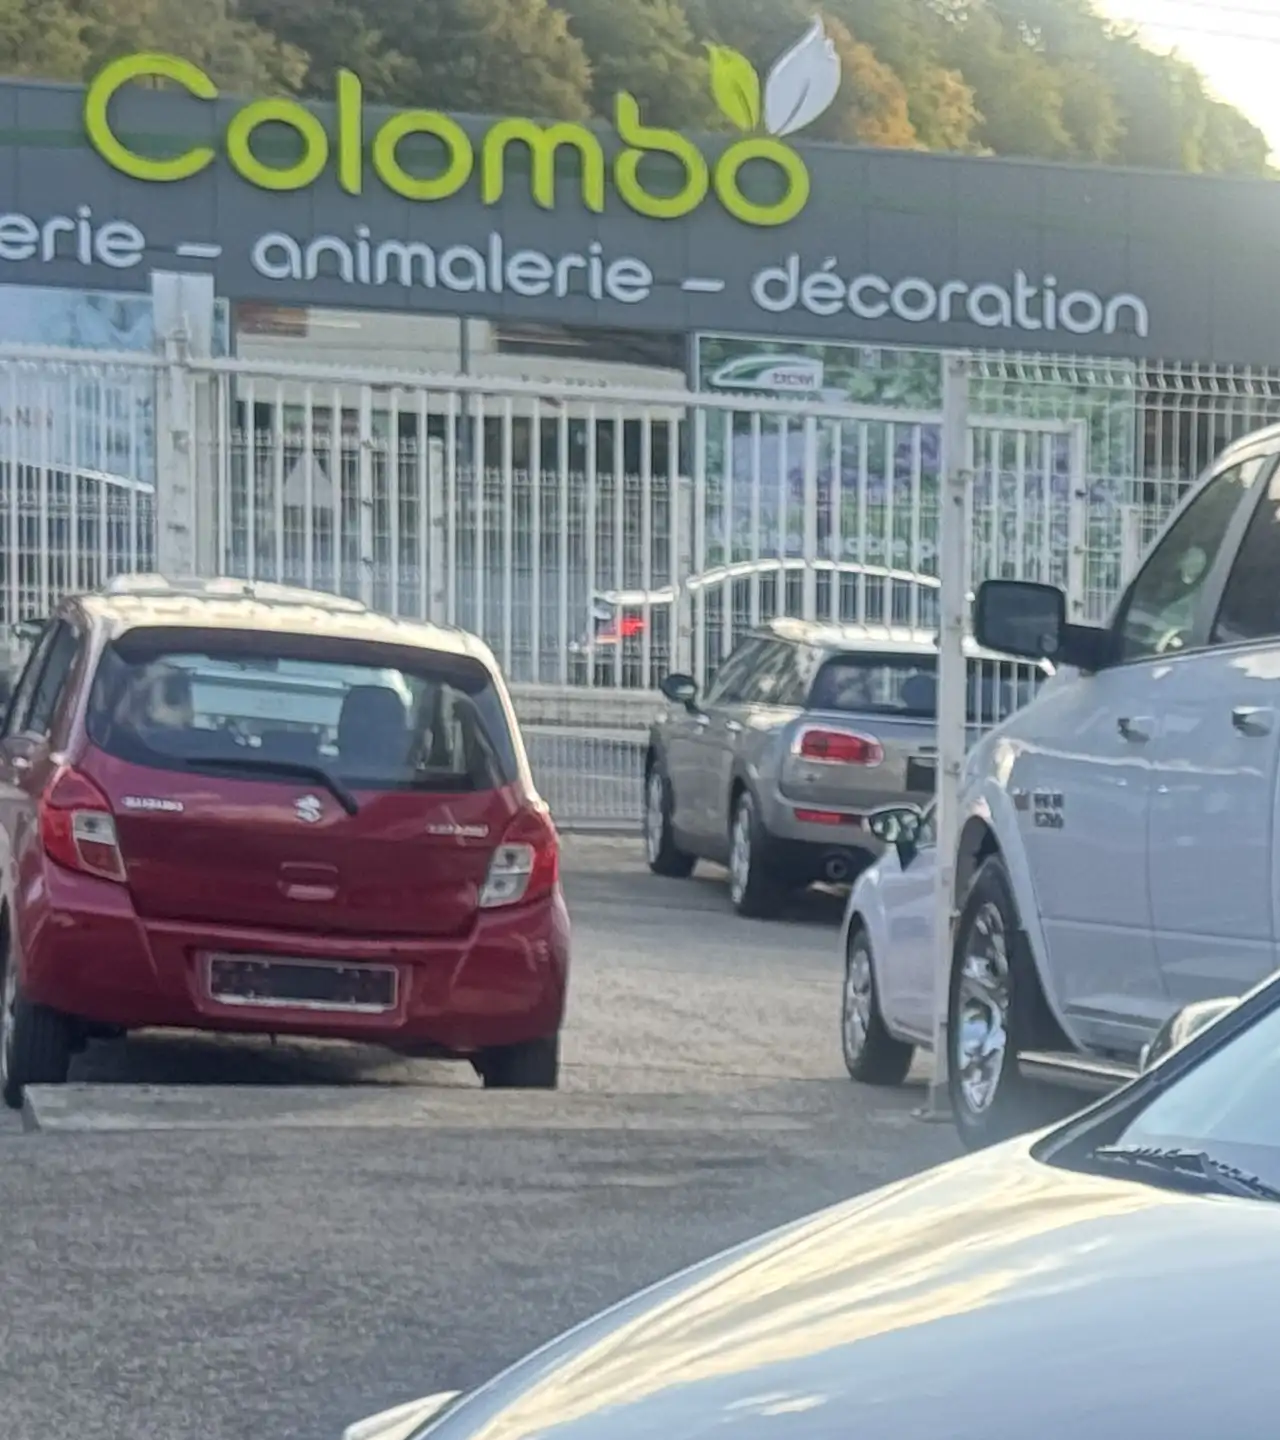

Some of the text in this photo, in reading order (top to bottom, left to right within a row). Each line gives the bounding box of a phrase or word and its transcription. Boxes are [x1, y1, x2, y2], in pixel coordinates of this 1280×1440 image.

[84, 53, 810, 226] Colombo
[251, 225, 653, 304] animalerie
[752, 253, 1149, 338] décoration
